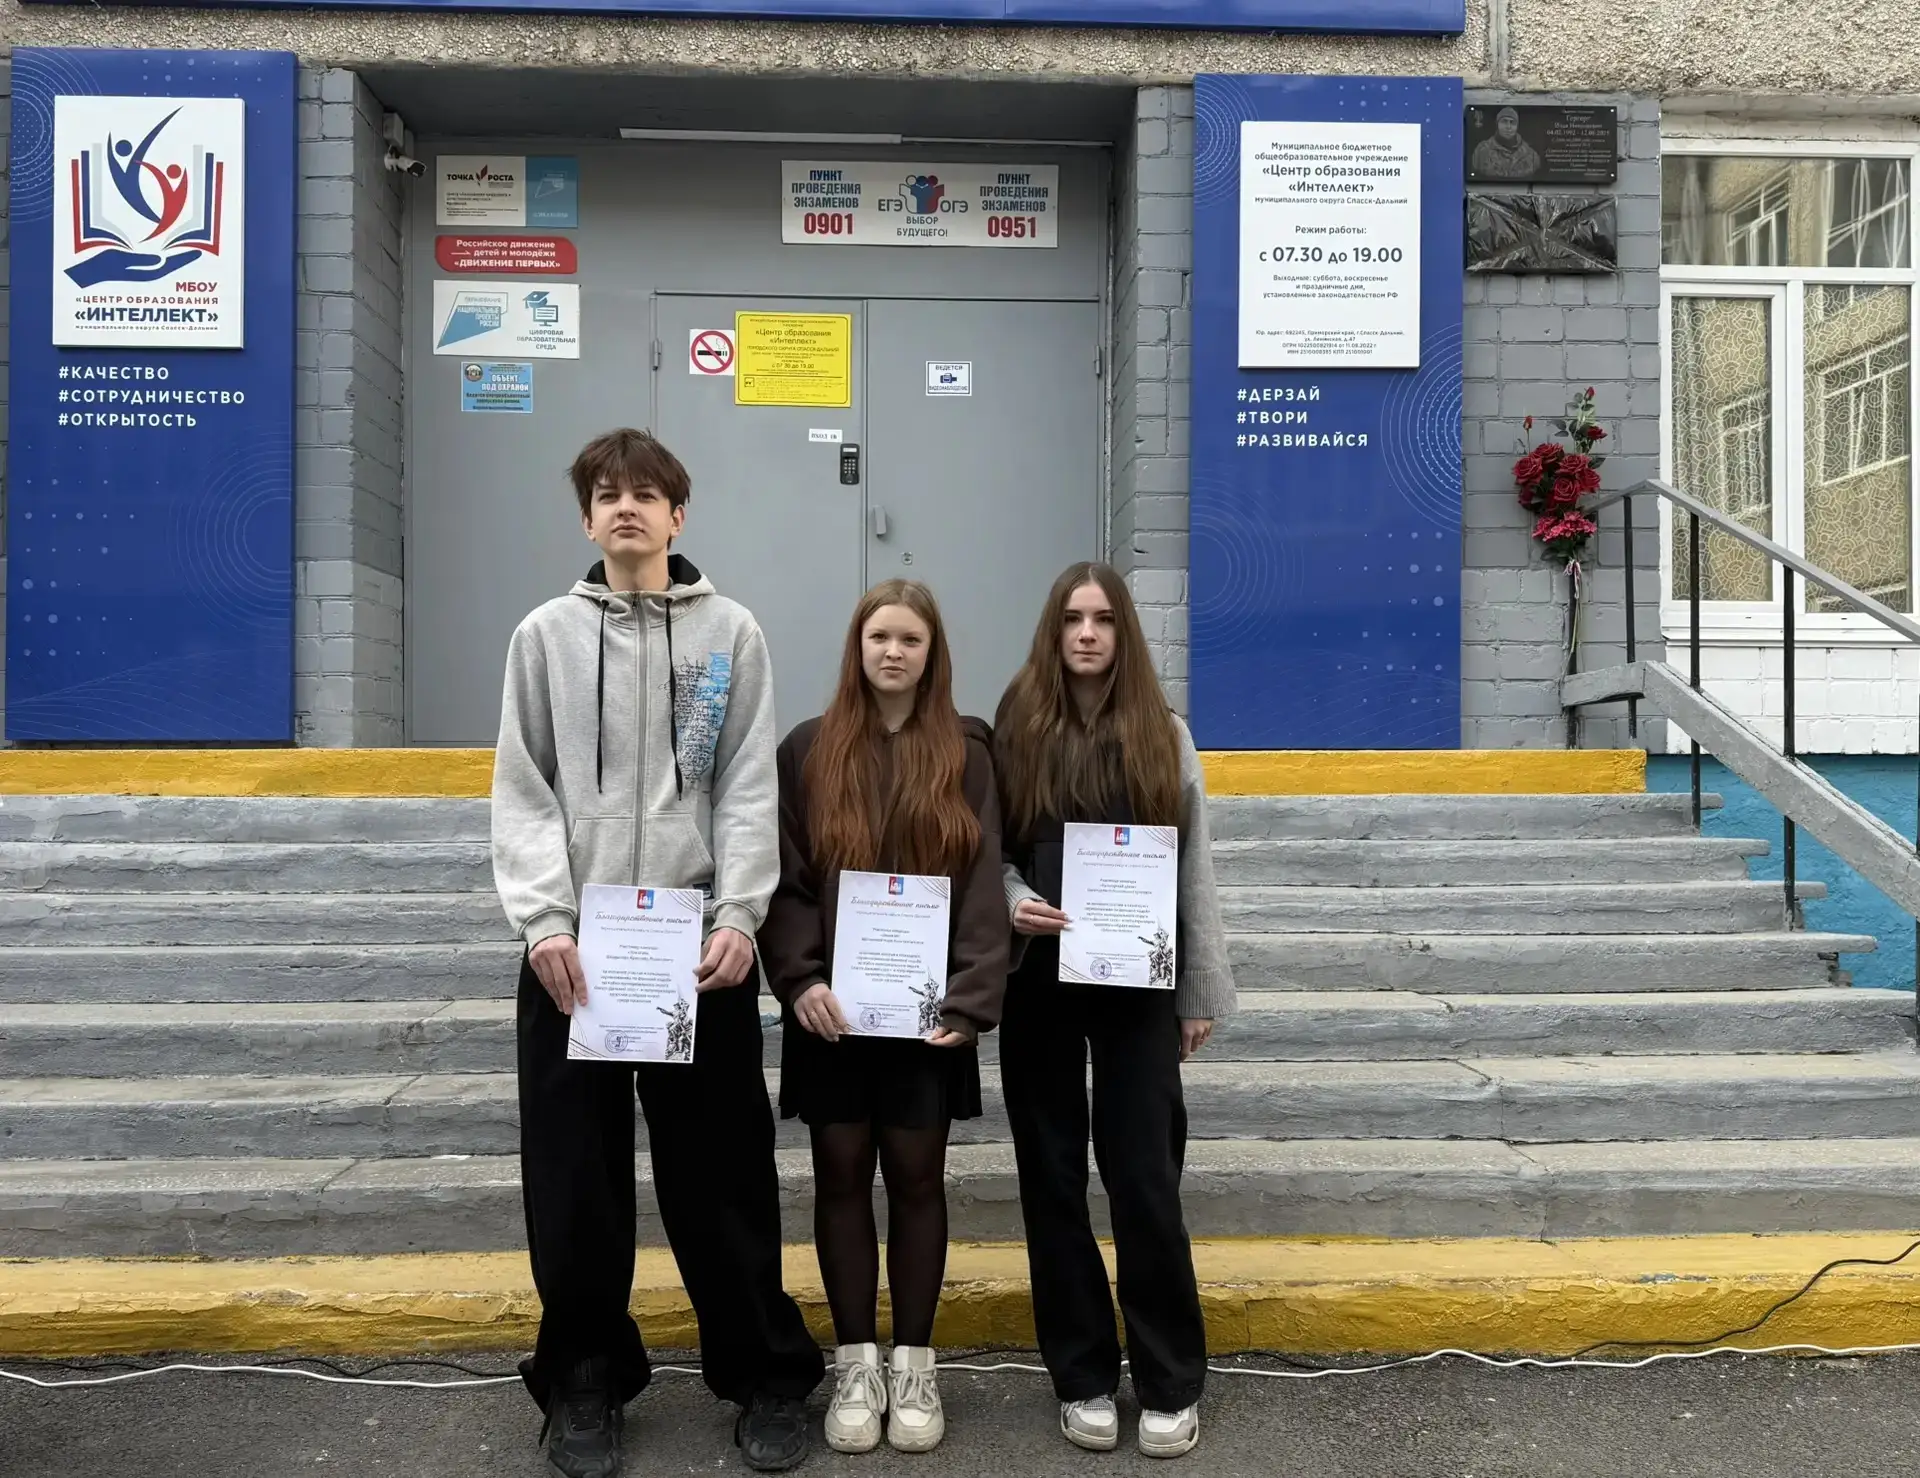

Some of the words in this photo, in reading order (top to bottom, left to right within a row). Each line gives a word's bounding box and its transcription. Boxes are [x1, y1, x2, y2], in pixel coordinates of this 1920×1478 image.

[1271, 142, 1340, 151] Муниципальное
[1342, 143, 1392, 152] бюджетное
[1254, 153, 1353, 162] общеобразовательное
[446, 173, 474, 181] ТОЧКА
[809, 170, 842, 182] ПУНКТ
[1262, 164, 1311, 178] «Центр
[1314, 165, 1400, 178] образования
[998, 173, 1031, 185] ПУНКТ
[792, 182, 862, 196] ПРОВЕДЕНИЯ
[979, 186, 1048, 199] ПРОВЕДЕНИЯ
[1288, 182, 1374, 192] «Интеллект»
[794, 196, 860, 209] ЭКЗАМЕНОВ
[878, 198, 904, 213] ЕГЭ
[940, 200, 968, 214] ОГЭ
[982, 200, 1046, 212] ЭКЗАМЕНОВ
[1346, 197, 1408, 205] Спасск-Дальний
[804, 212, 854, 235] 0901
[906, 216, 939, 226] ВЫБОР
[896, 227, 948, 238] БУДУЩЕГО!
[987, 216, 1037, 239] 0951
[1295, 226, 1326, 234] Режим
[1328, 226, 1367, 235] работы:
[456, 239, 508, 248] Российское
[474, 248, 500, 257] детей
[510, 249, 556, 258] молодёжи
[1259, 251, 1267, 262] с
[1272, 247, 1323, 263] 07.30
[1328, 252, 1348, 264] до
[1352, 248, 1403, 263] 19.00
[454, 259, 514, 268] «ДВИЖЕНИЕ
[516, 260, 560, 268] ПЕРВЫХ»
[175, 281, 218, 292] МБОУ
[76, 296, 123, 304] «ЦЕНТР
[126, 296, 219, 305] ОБРАЗОВАНИЯ
[74, 307, 219, 323] «ИНТЕЛЛЕКТ»
[516, 336, 576, 344] ОБРАЗОВАТЕЛЬНАЯ
[58, 366, 169, 380] #КАЧЕСТВО
[492, 374, 518, 382] ОБЪЕКТ
[58, 389, 245, 405] #СОТРУДНИЧЕСТВО
[1237, 386, 1320, 403] #ДЕРЗАЙ
[58, 413, 197, 427] #ОТКРЫТОСТЬ
[1237, 411, 1308, 424] #ТВОРИ
[1236, 432, 1368, 447] #РАЗВИВАЙСЯ
